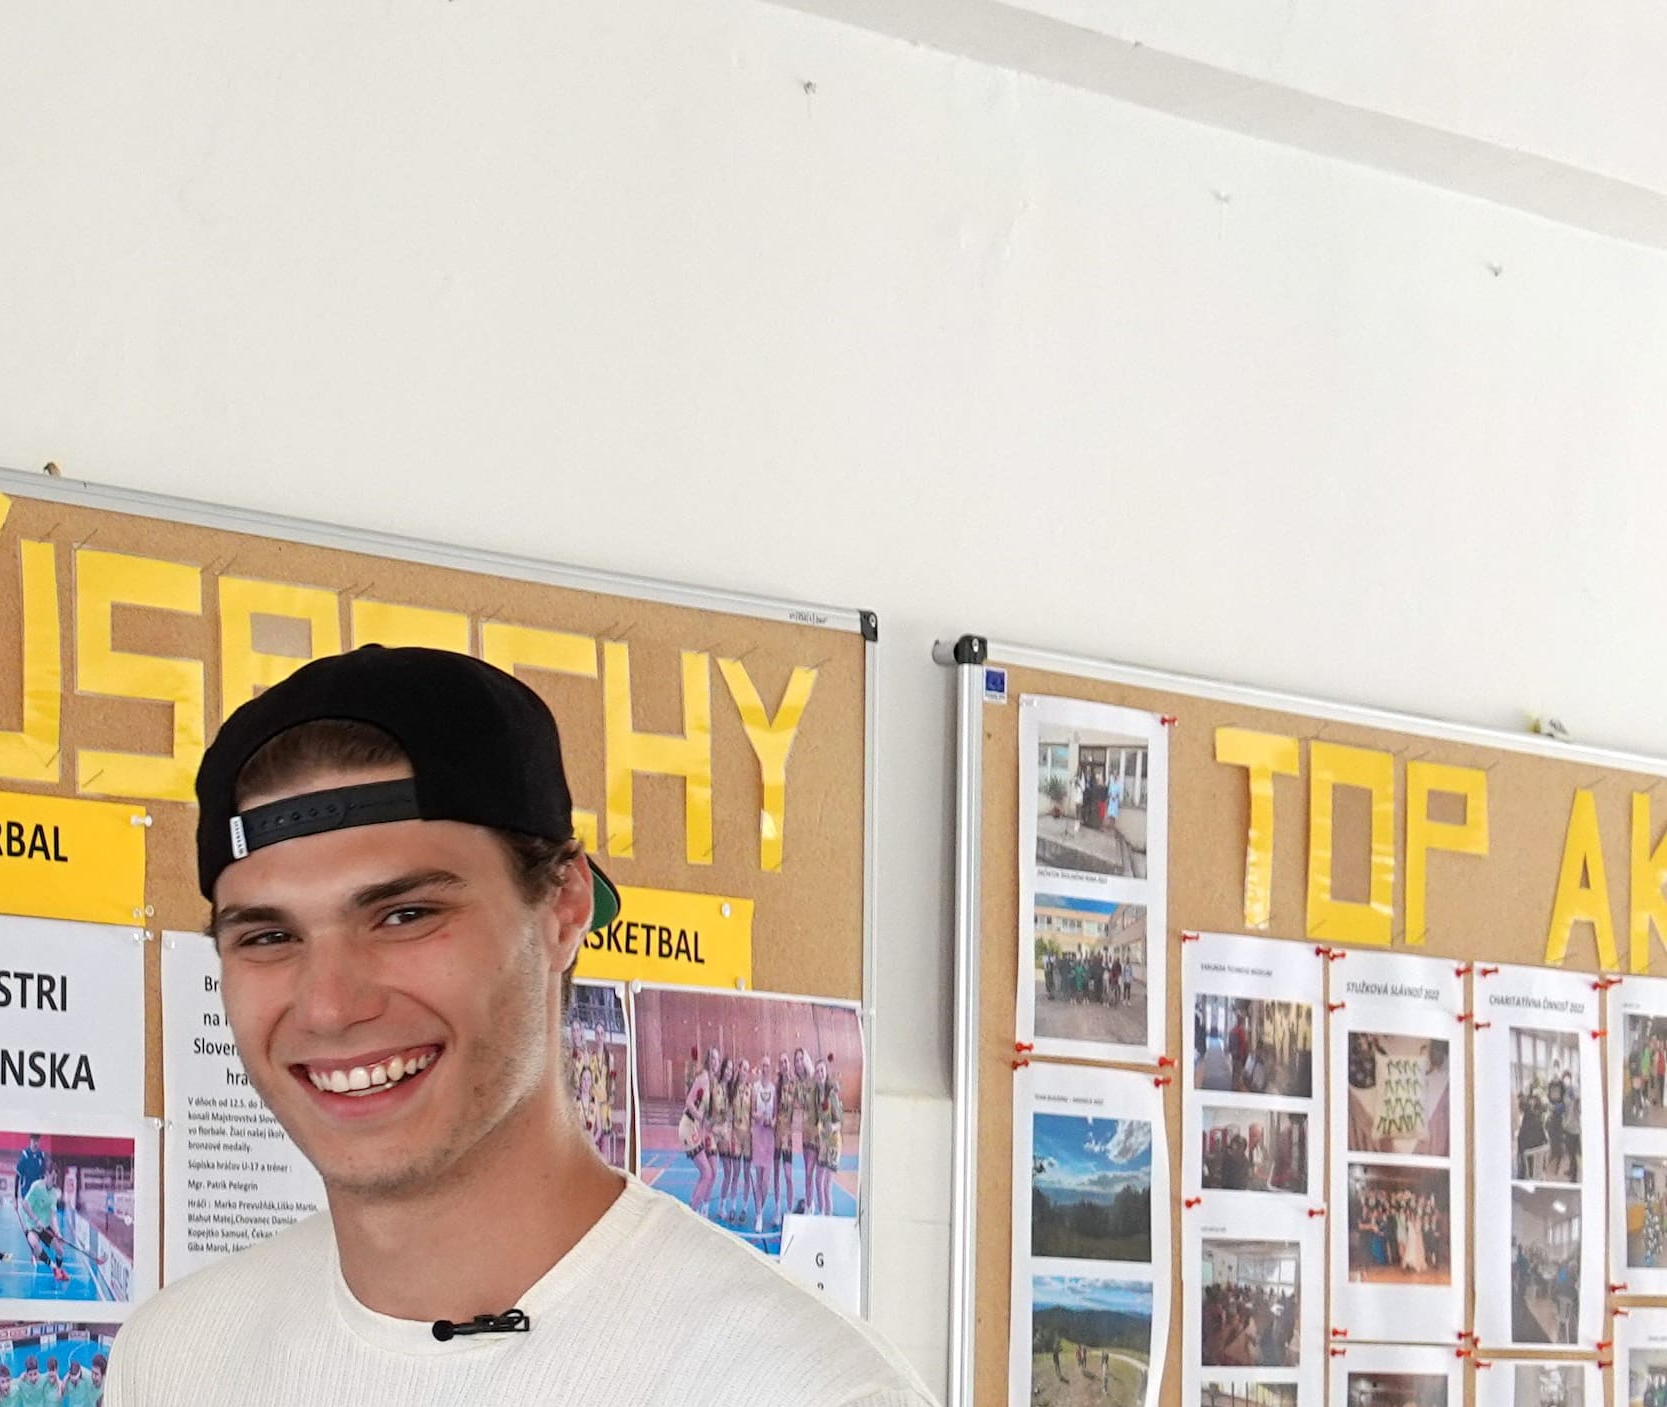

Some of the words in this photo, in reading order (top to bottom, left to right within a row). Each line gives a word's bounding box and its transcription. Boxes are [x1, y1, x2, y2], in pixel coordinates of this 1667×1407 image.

[1214, 727, 1489, 947] TOP
[583, 920, 705, 965] SKETBAL
[203, 1013, 220, 1026] na
[194, 1038, 241, 1056] Sloven
